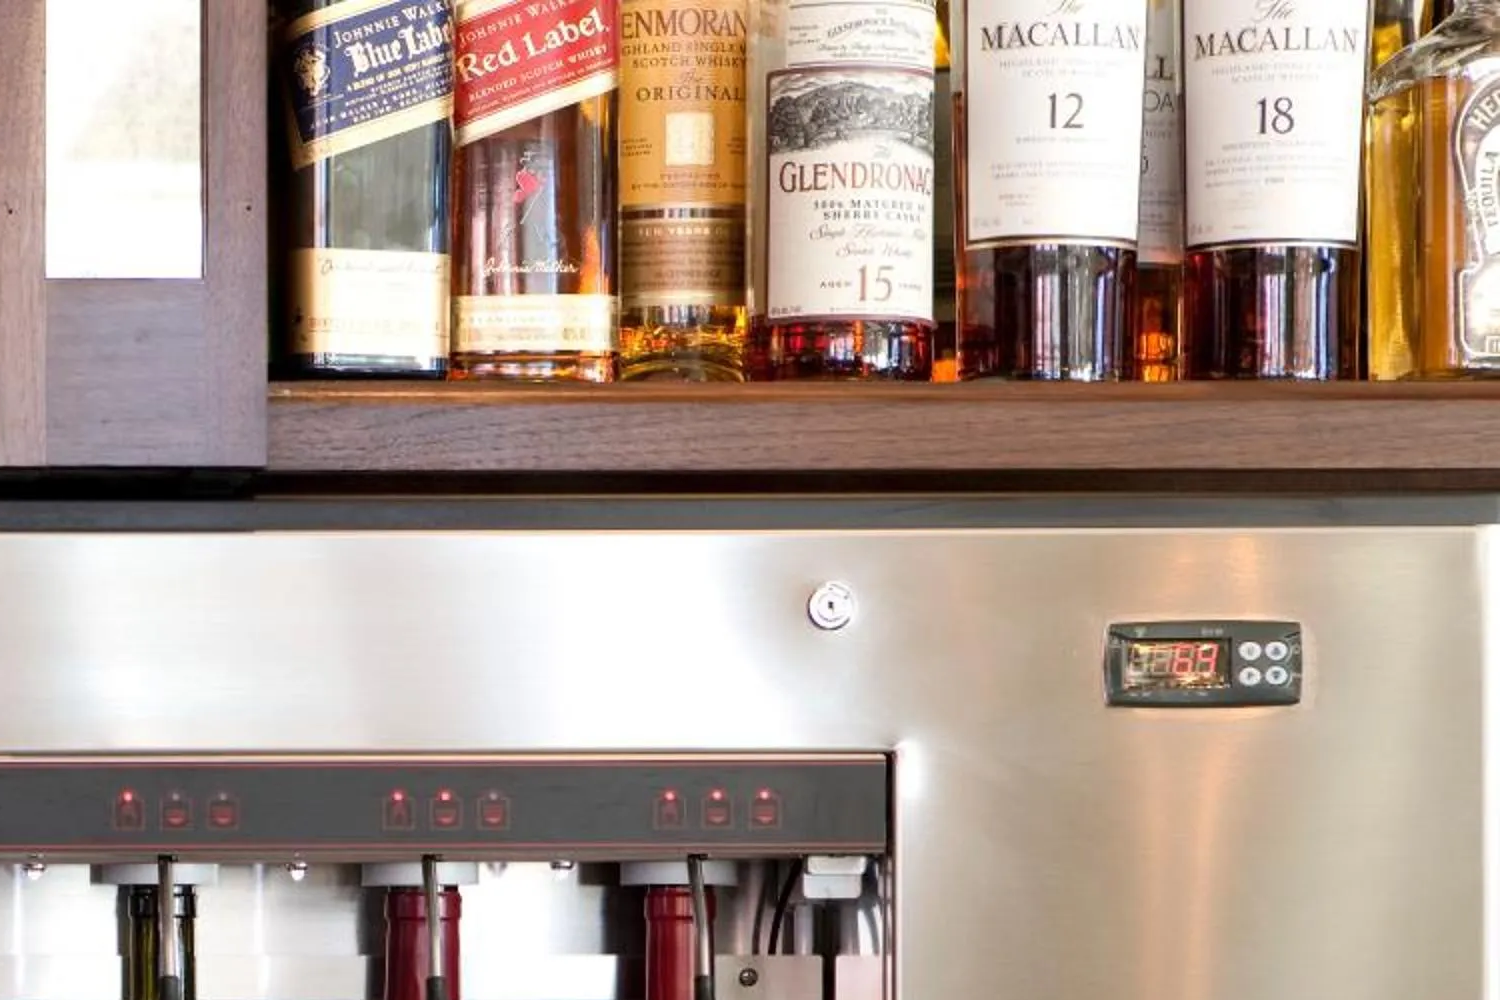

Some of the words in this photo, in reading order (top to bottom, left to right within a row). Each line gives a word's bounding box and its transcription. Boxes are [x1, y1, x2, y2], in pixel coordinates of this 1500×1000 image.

[333, 15, 400, 48] JOHNNIE
[459, 12, 523, 48] JOHNNIE
[980, 21, 1140, 51] MACALLAN
[1194, 26, 1360, 61] MACALLAN
[344, 39, 403, 77] Blue
[456, 39, 521, 83] Red
[636, 86, 745, 102] ORIGINAL
[1048, 92, 1084, 129] 12
[1257, 96, 1294, 135] 18
[858, 264, 895, 302] 15
